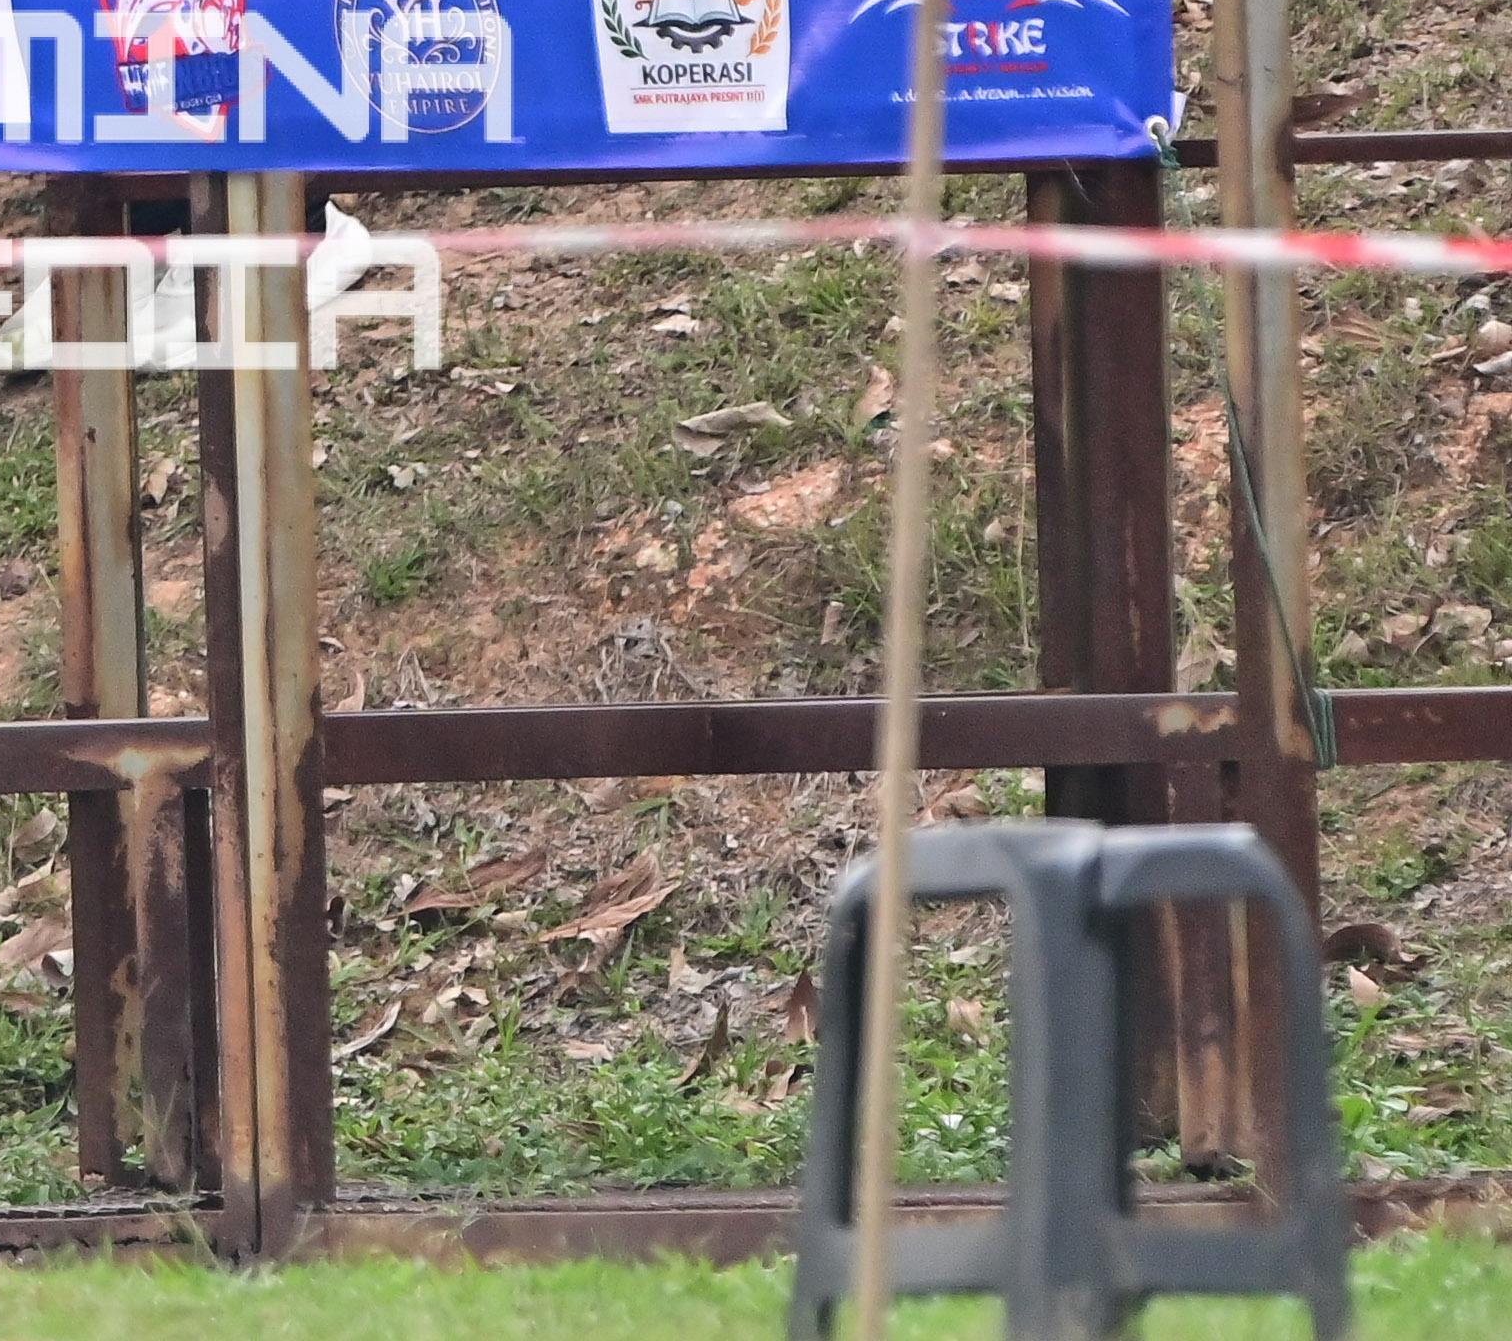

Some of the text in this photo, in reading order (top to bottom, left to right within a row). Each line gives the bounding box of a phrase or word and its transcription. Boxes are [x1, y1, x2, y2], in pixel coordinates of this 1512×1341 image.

[642, 63, 753, 86] KOPERASI
[390, 97, 472, 115] EMPIRE
[633, 93, 653, 104] SMK
[655, 91, 708, 106] PUTRAJAYA
[710, 90, 744, 102] PRESINT
